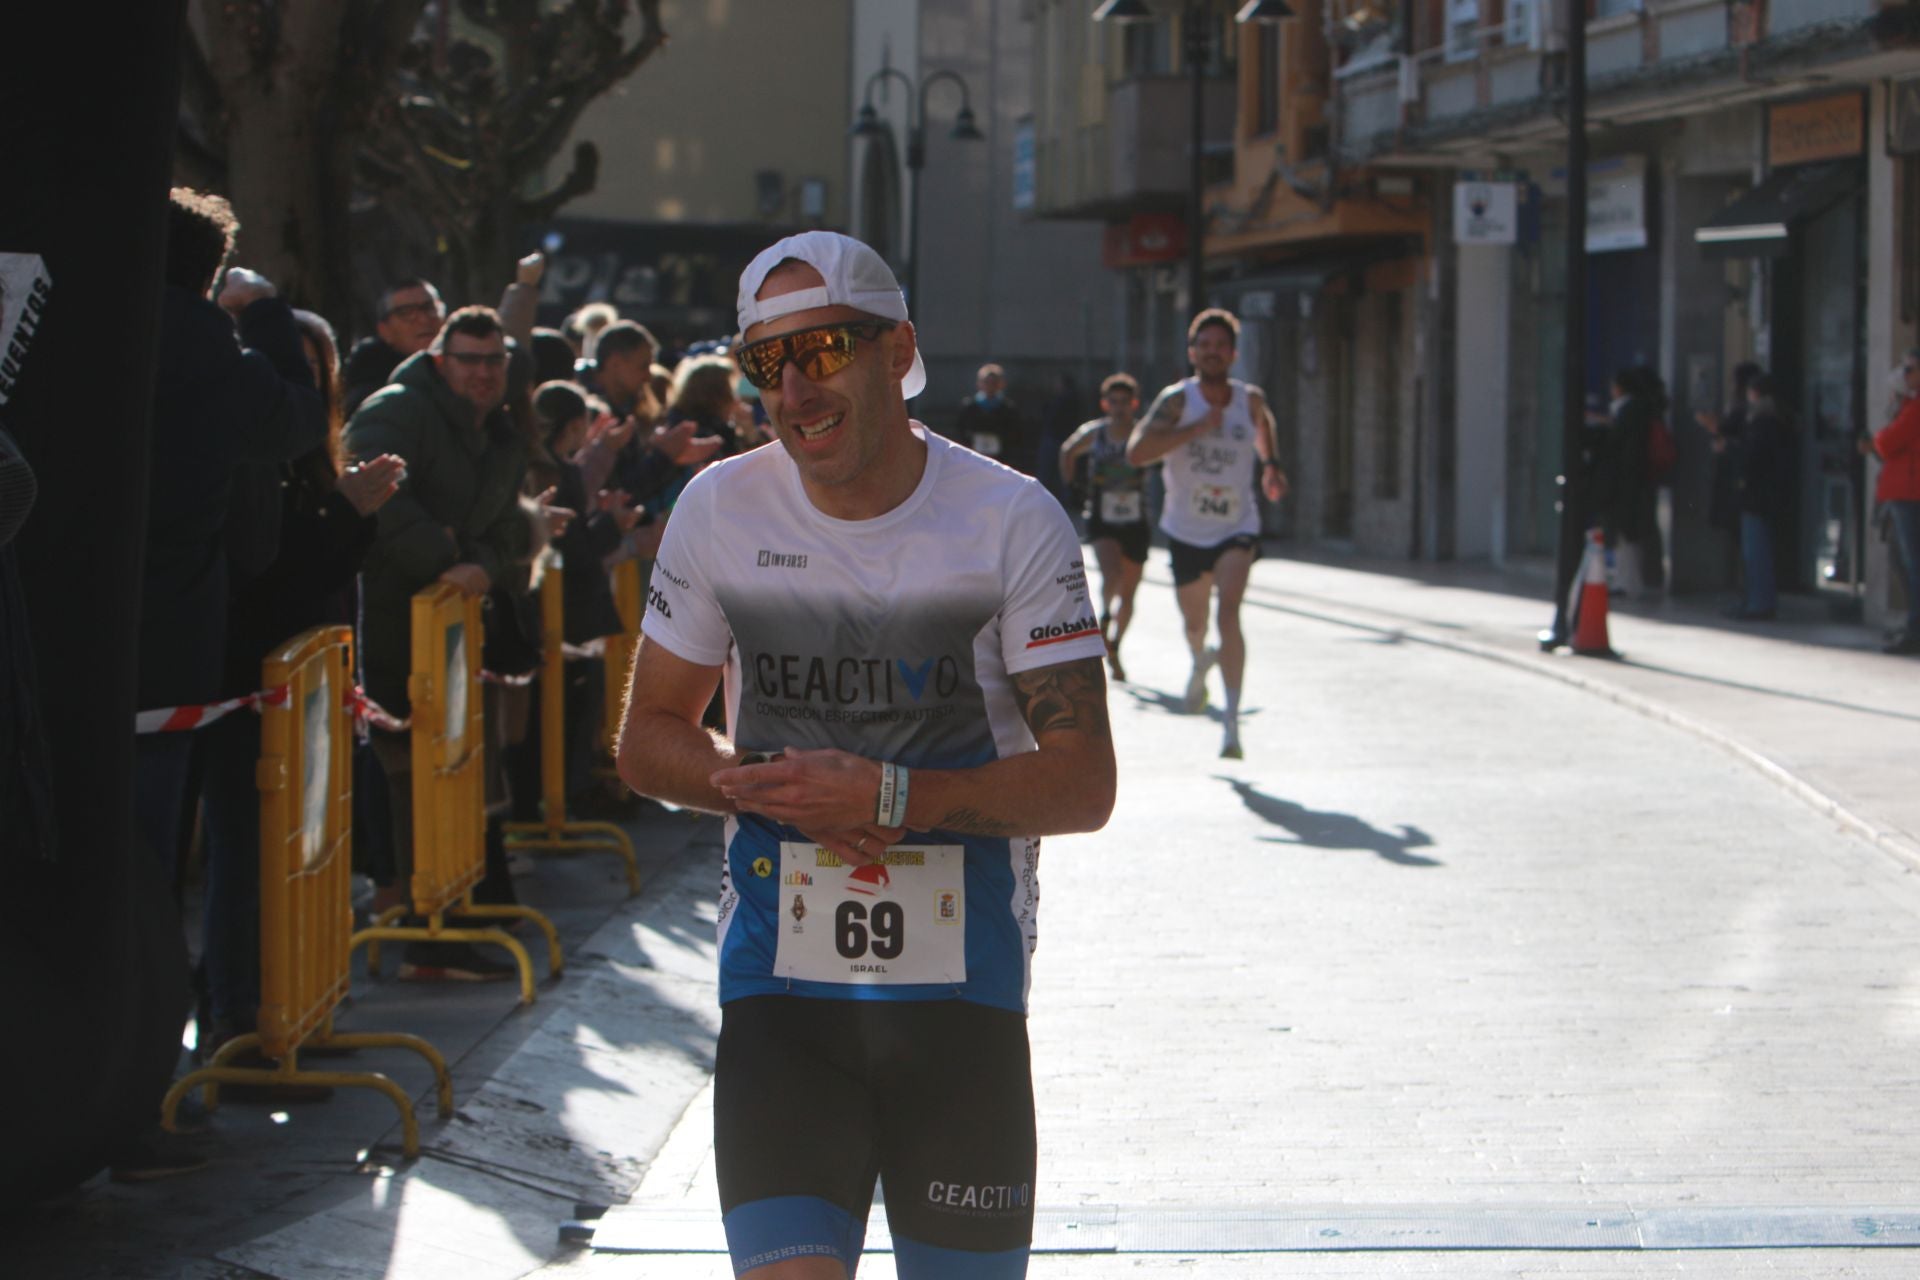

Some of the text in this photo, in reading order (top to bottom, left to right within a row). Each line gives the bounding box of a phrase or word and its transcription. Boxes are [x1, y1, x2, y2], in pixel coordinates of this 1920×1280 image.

[756, 652, 959, 704] CEACTIVO
[824, 709, 900, 723] ESPECTRO
[784, 870, 813, 886] LLENA
[834, 900, 904, 959] 69
[850, 964, 888, 974] ISRAEL
[928, 1181, 1029, 1209] CEACTIVO
